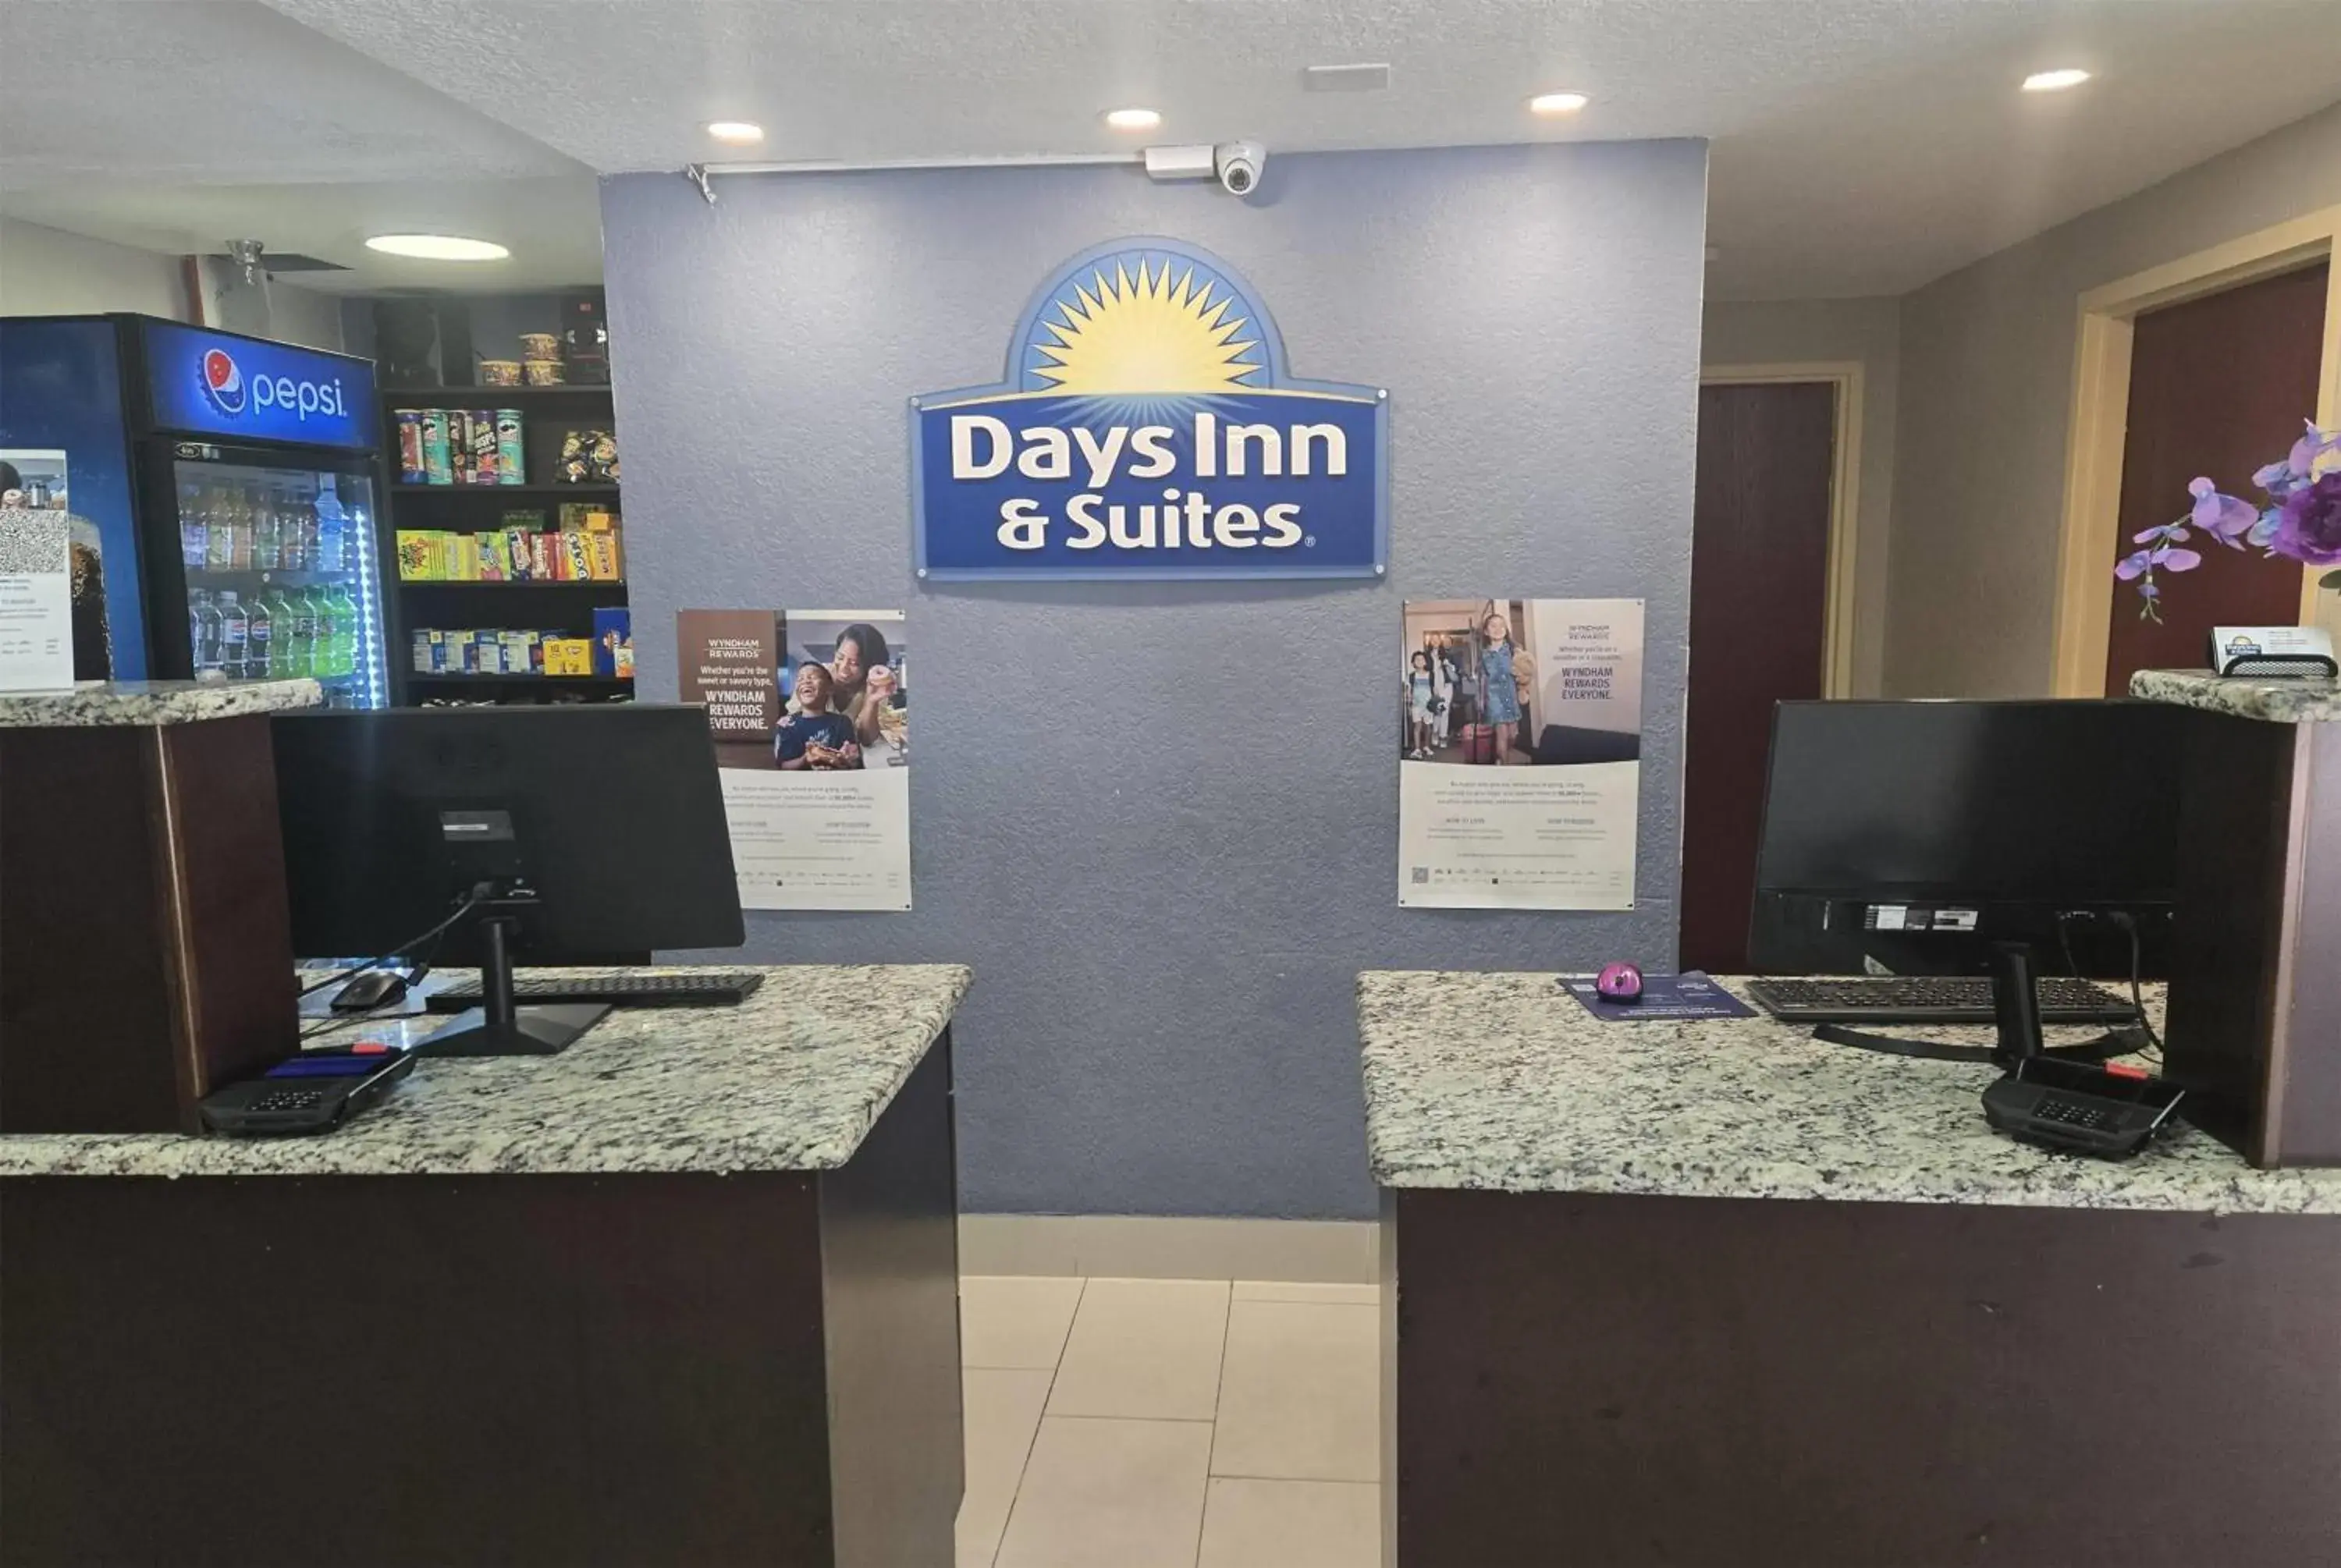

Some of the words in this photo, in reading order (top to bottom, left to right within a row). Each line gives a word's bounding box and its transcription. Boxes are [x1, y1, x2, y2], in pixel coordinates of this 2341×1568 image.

[252, 374, 344, 421] pepsi
[950, 413, 1177, 488] Days
[1195, 411, 1348, 477] Inn
[996, 498, 1050, 549] &
[1065, 488, 1302, 549] Suites
[708, 638, 759, 648] WYNDHAM
[709, 649, 760, 658] REWARDS
[700, 665, 731, 675] Whether
[732, 666, 755, 676] you're
[1561, 666, 1613, 677] WYNDHAM
[1564, 678, 1610, 688] REWARDS
[705, 690, 766, 702] WYNDHAM
[709, 704, 763, 716] REWARDS
